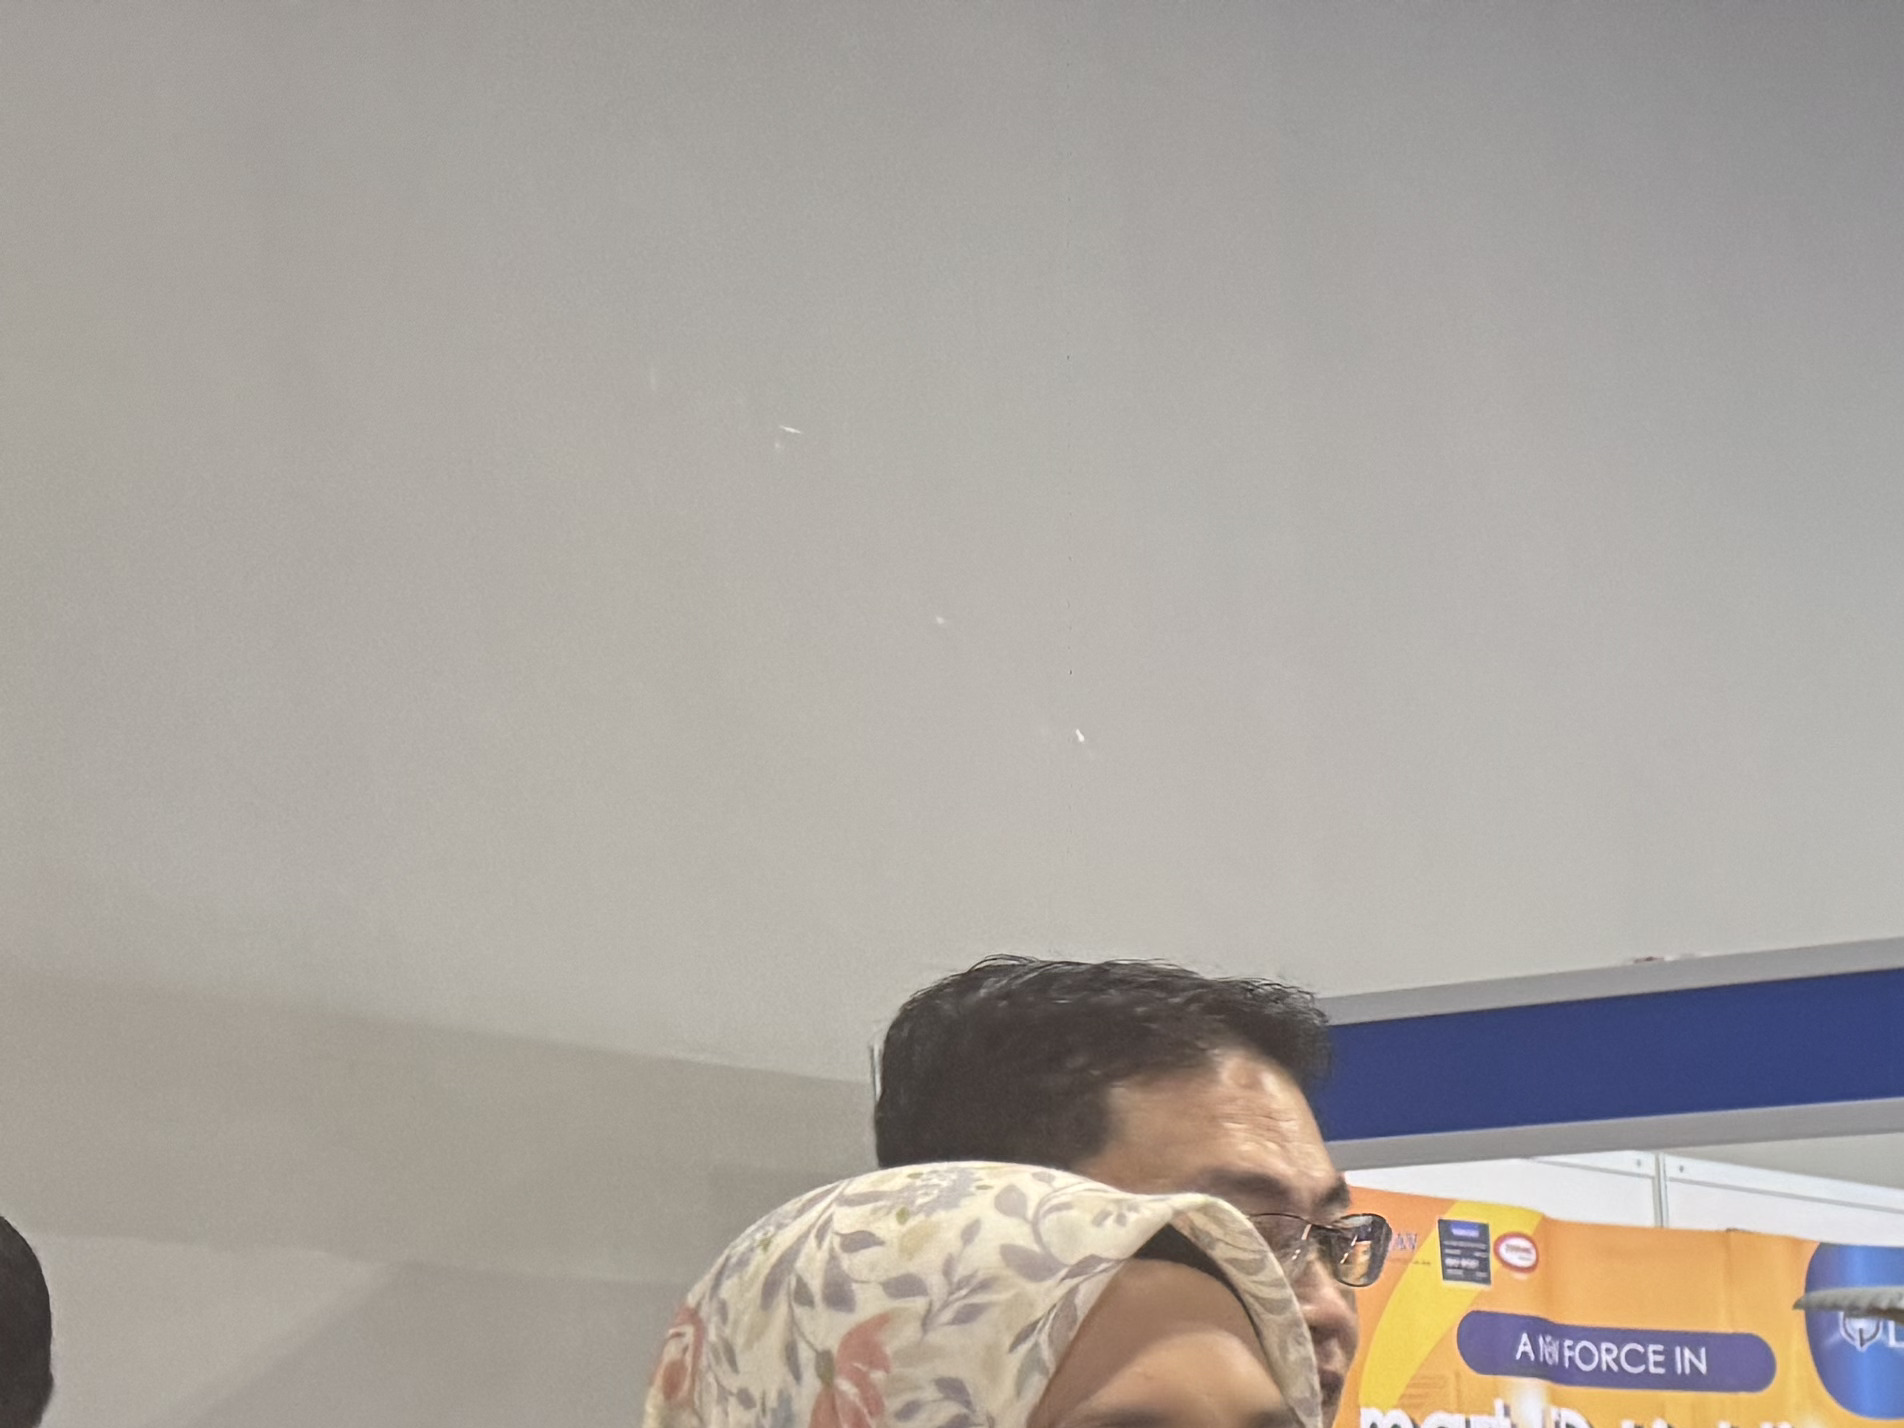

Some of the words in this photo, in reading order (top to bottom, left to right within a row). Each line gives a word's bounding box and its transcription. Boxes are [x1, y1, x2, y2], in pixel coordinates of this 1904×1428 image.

[1515, 1332, 1535, 1361] A
[1564, 1338, 1666, 1375] FORCE
[1676, 1346, 1708, 1374] IN
